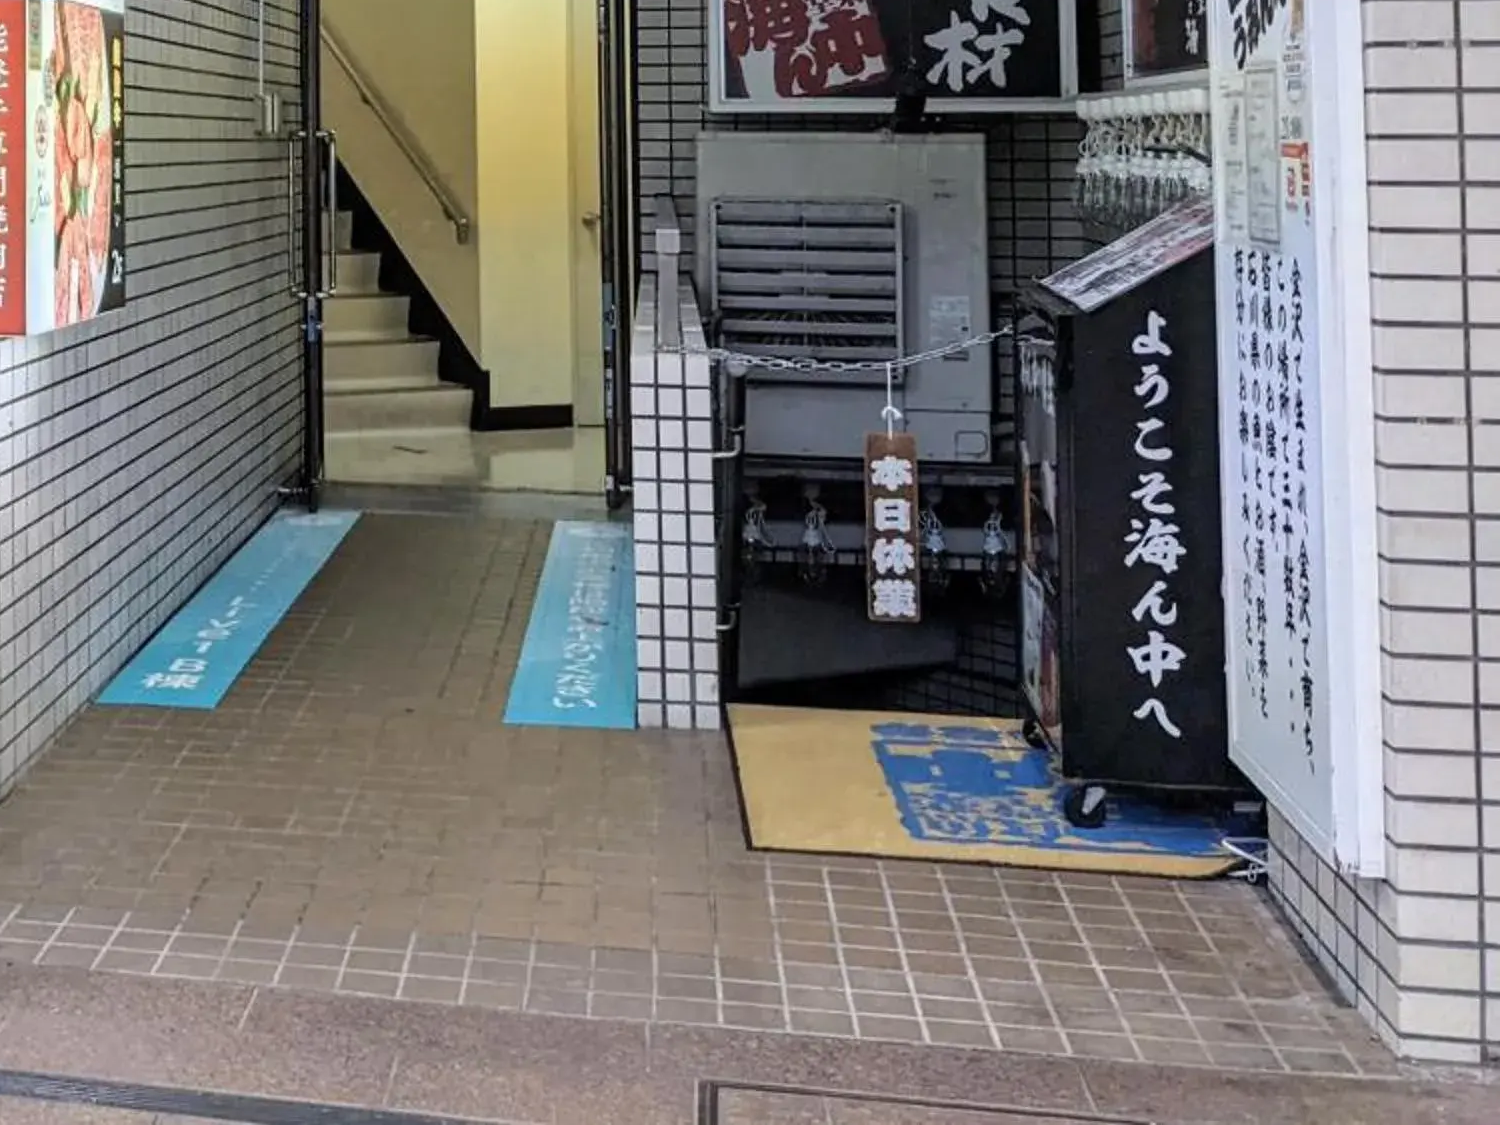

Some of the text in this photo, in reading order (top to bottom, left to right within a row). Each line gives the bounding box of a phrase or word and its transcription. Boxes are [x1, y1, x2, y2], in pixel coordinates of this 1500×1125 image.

[870, 455, 918, 619] 本日休業
[1124, 315, 1188, 741] ようこそ海ん中へ
